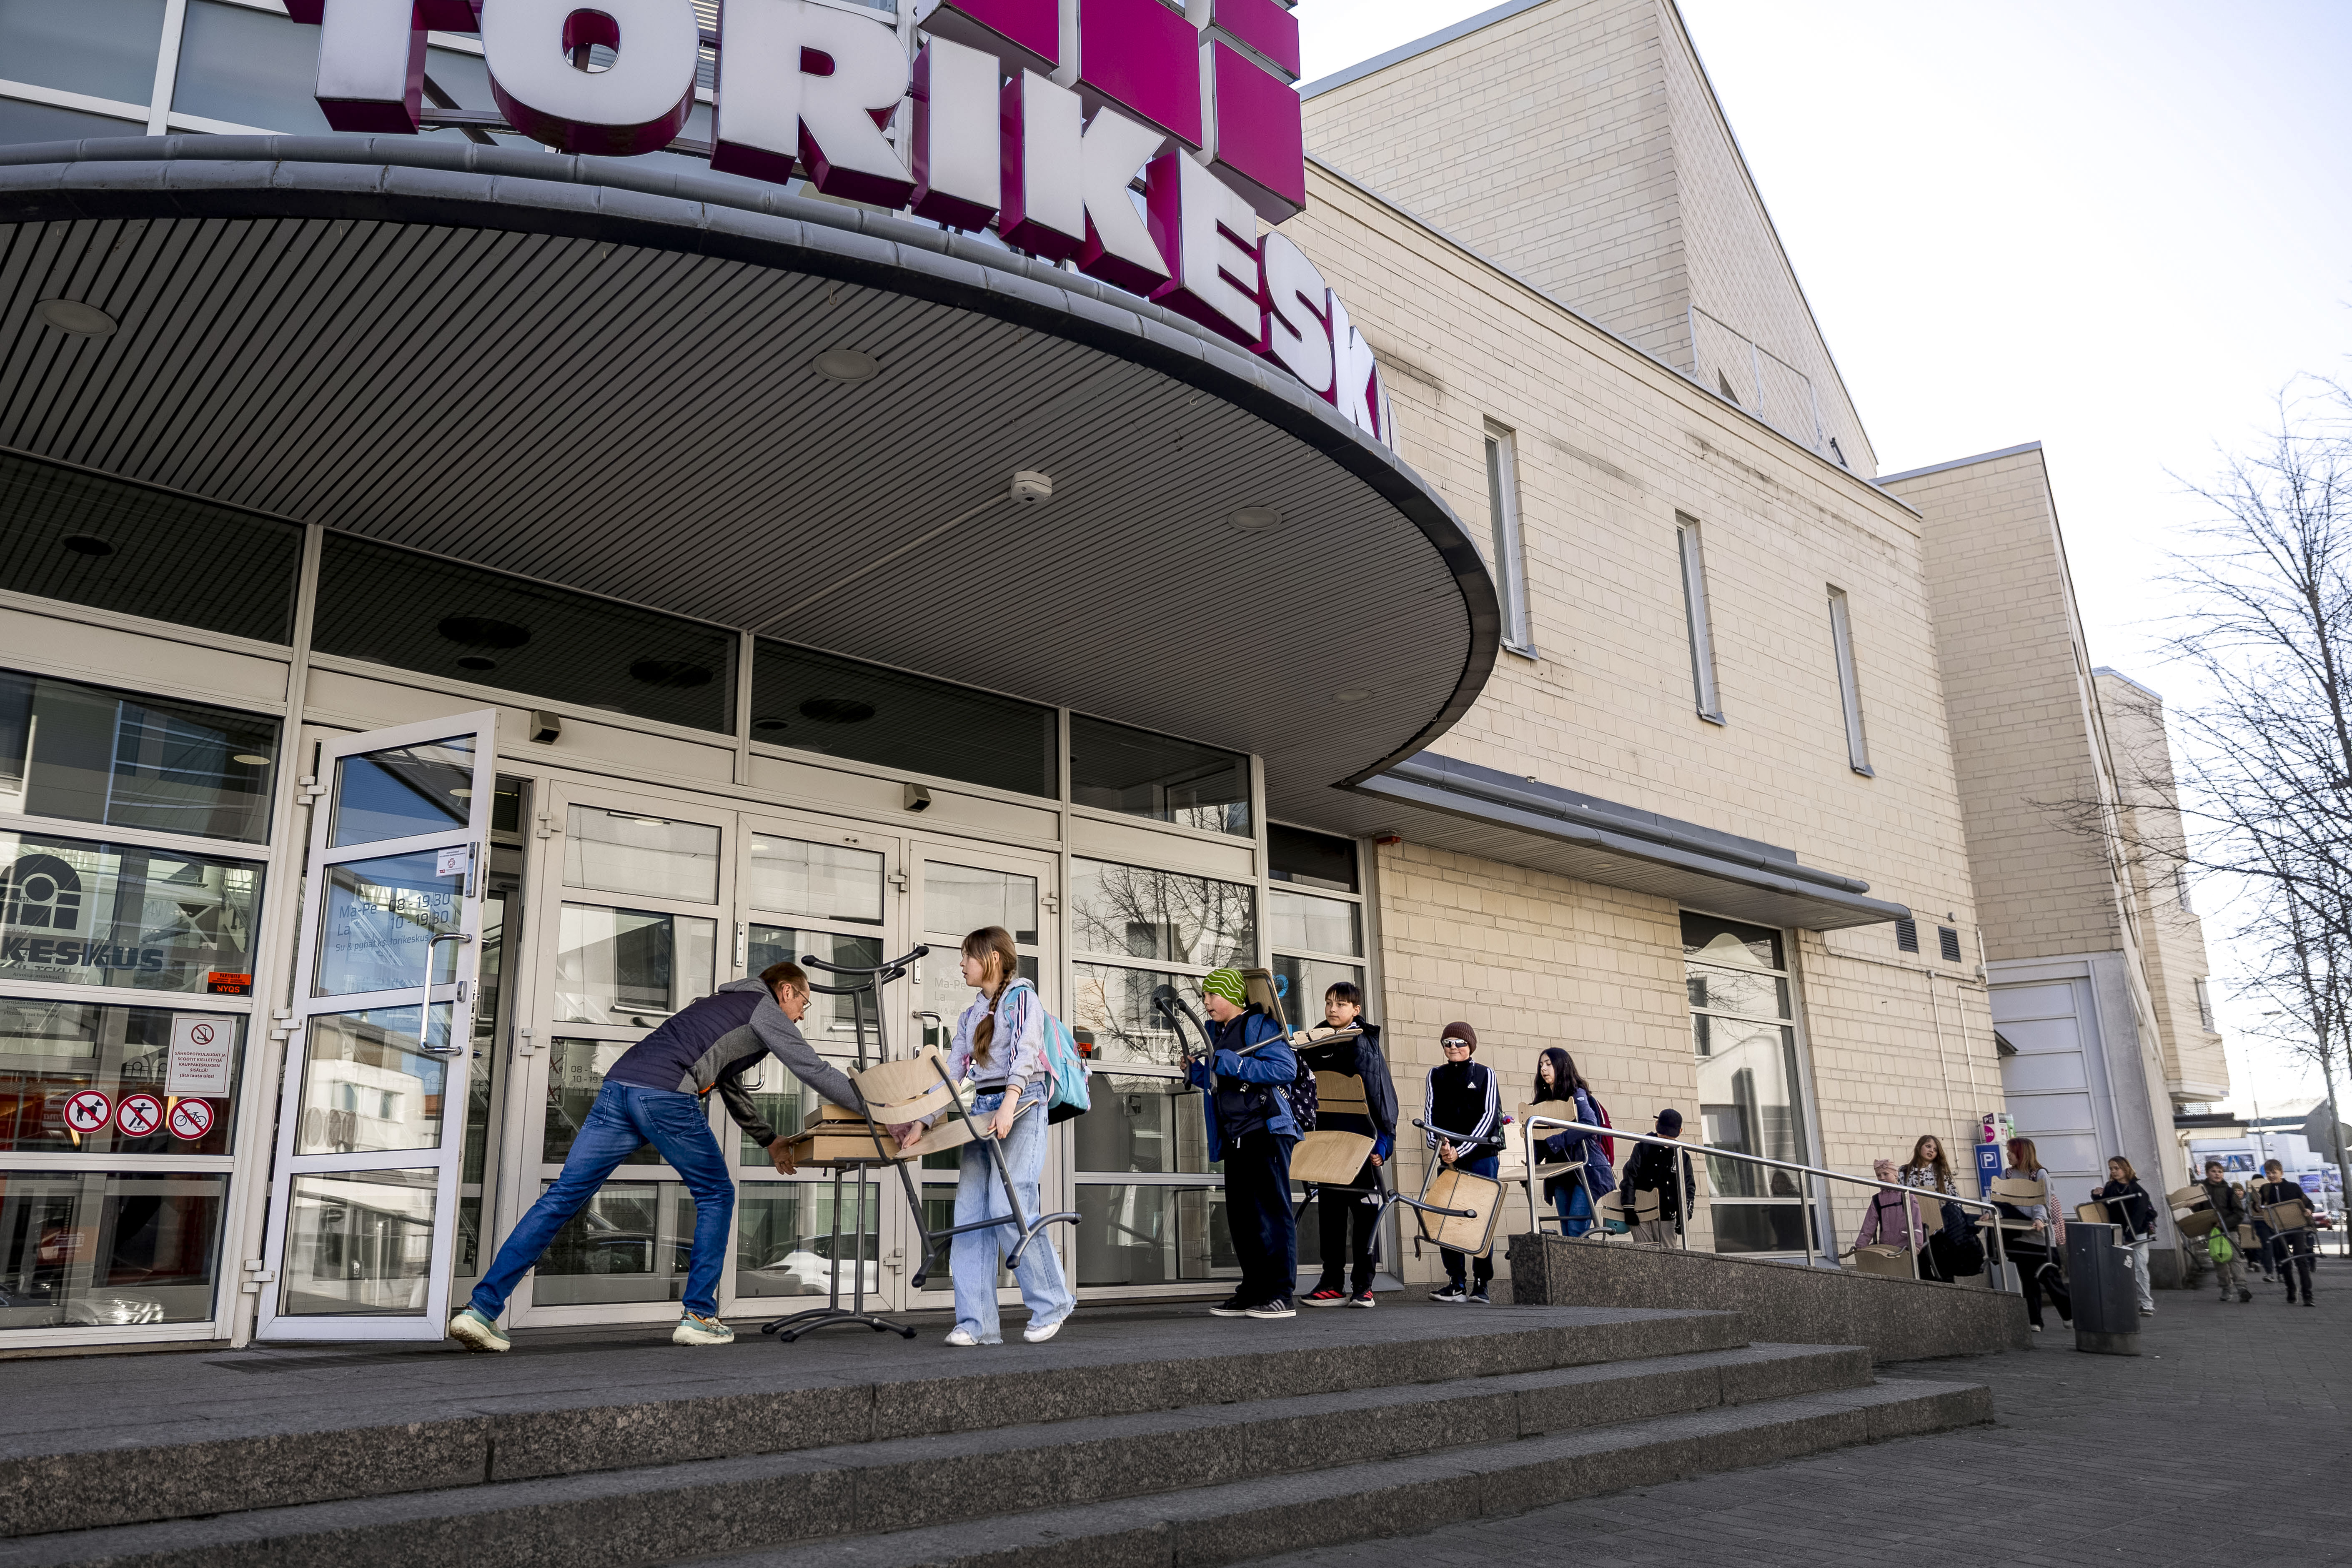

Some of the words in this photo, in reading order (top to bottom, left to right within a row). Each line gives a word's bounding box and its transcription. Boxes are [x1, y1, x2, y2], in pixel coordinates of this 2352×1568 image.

[340, 903, 377, 918] Ma-Pe
[388, 898, 405, 912] 08
[417, 892, 450, 909] 19.30
[337, 924, 351, 936] La
[391, 916, 403, 929] 10
[336, 943, 345, 952] Su
[934, 977, 966, 990] Ma-Pe
[934, 991, 945, 1001] La
[1983, 1154, 1994, 1167] P
